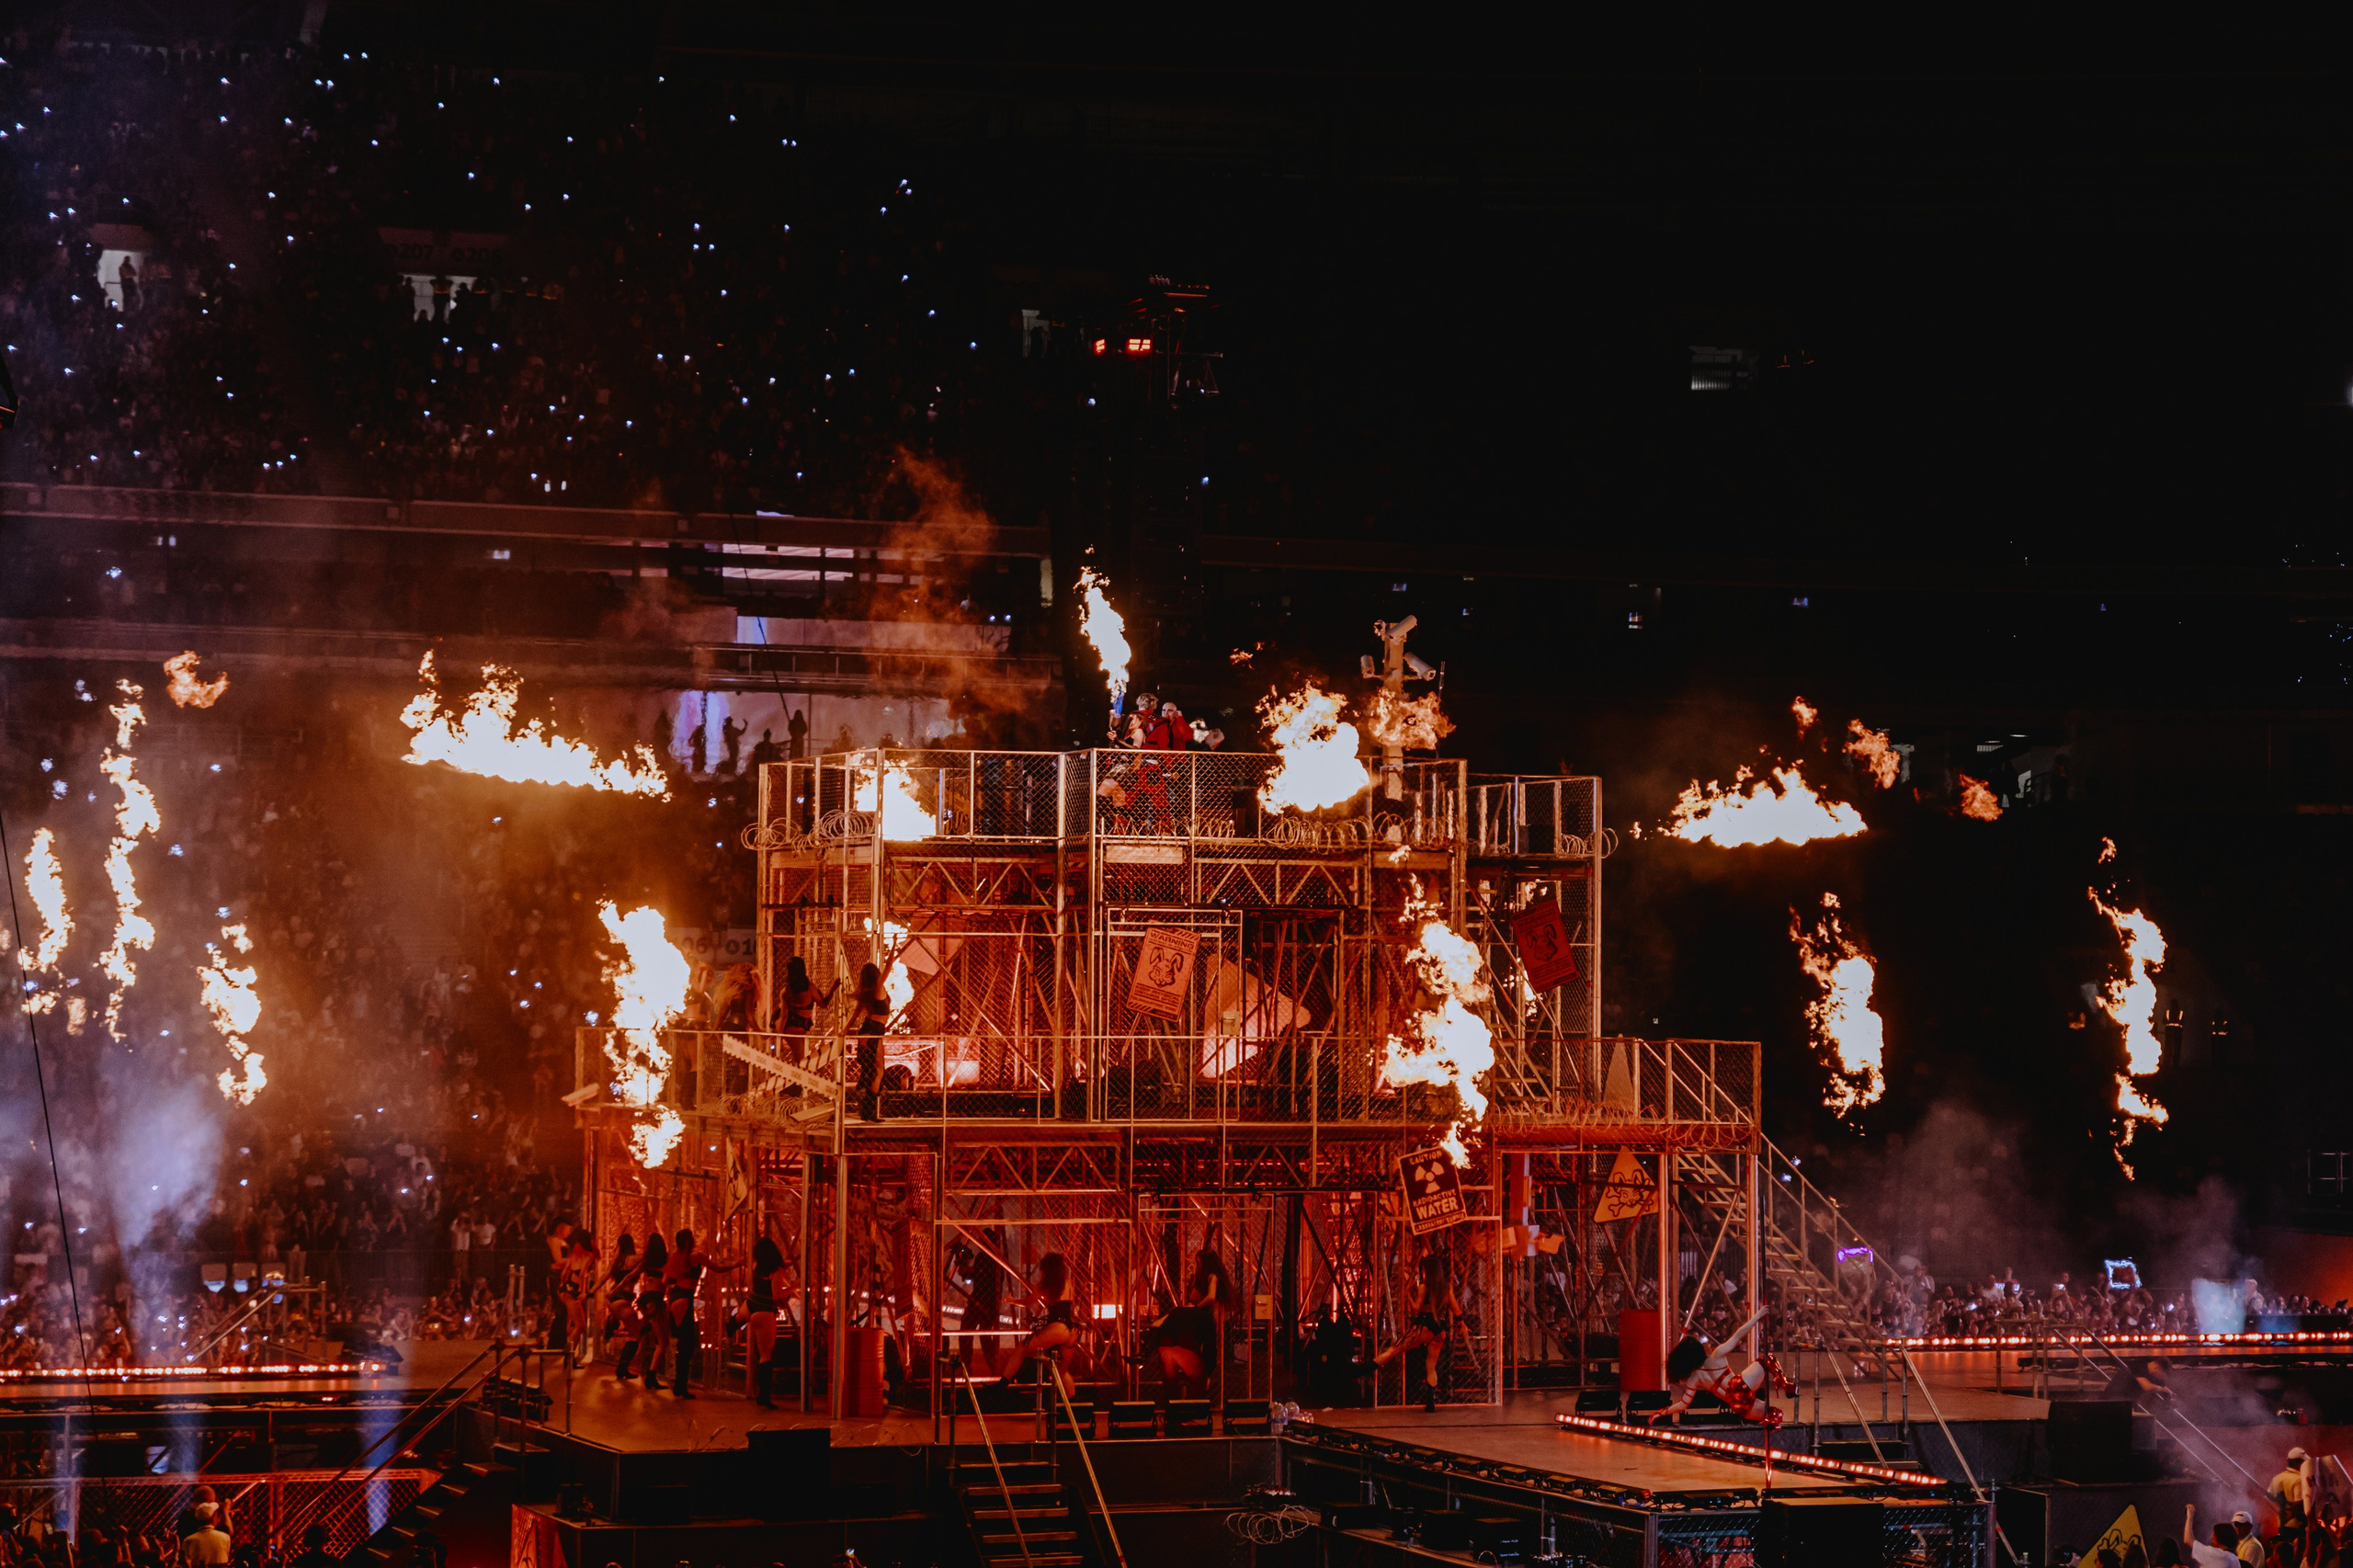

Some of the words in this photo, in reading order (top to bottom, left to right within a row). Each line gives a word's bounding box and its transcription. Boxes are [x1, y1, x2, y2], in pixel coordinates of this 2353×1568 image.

[400, 243, 433, 259] 207
[467, 247, 502, 265] 206
[1151, 932, 1194, 949] WARNING
[1409, 1150, 1443, 1165] CAUTION
[1413, 1188, 1457, 1208] RADIOACTIVE
[1416, 1197, 1459, 1220] WATER
